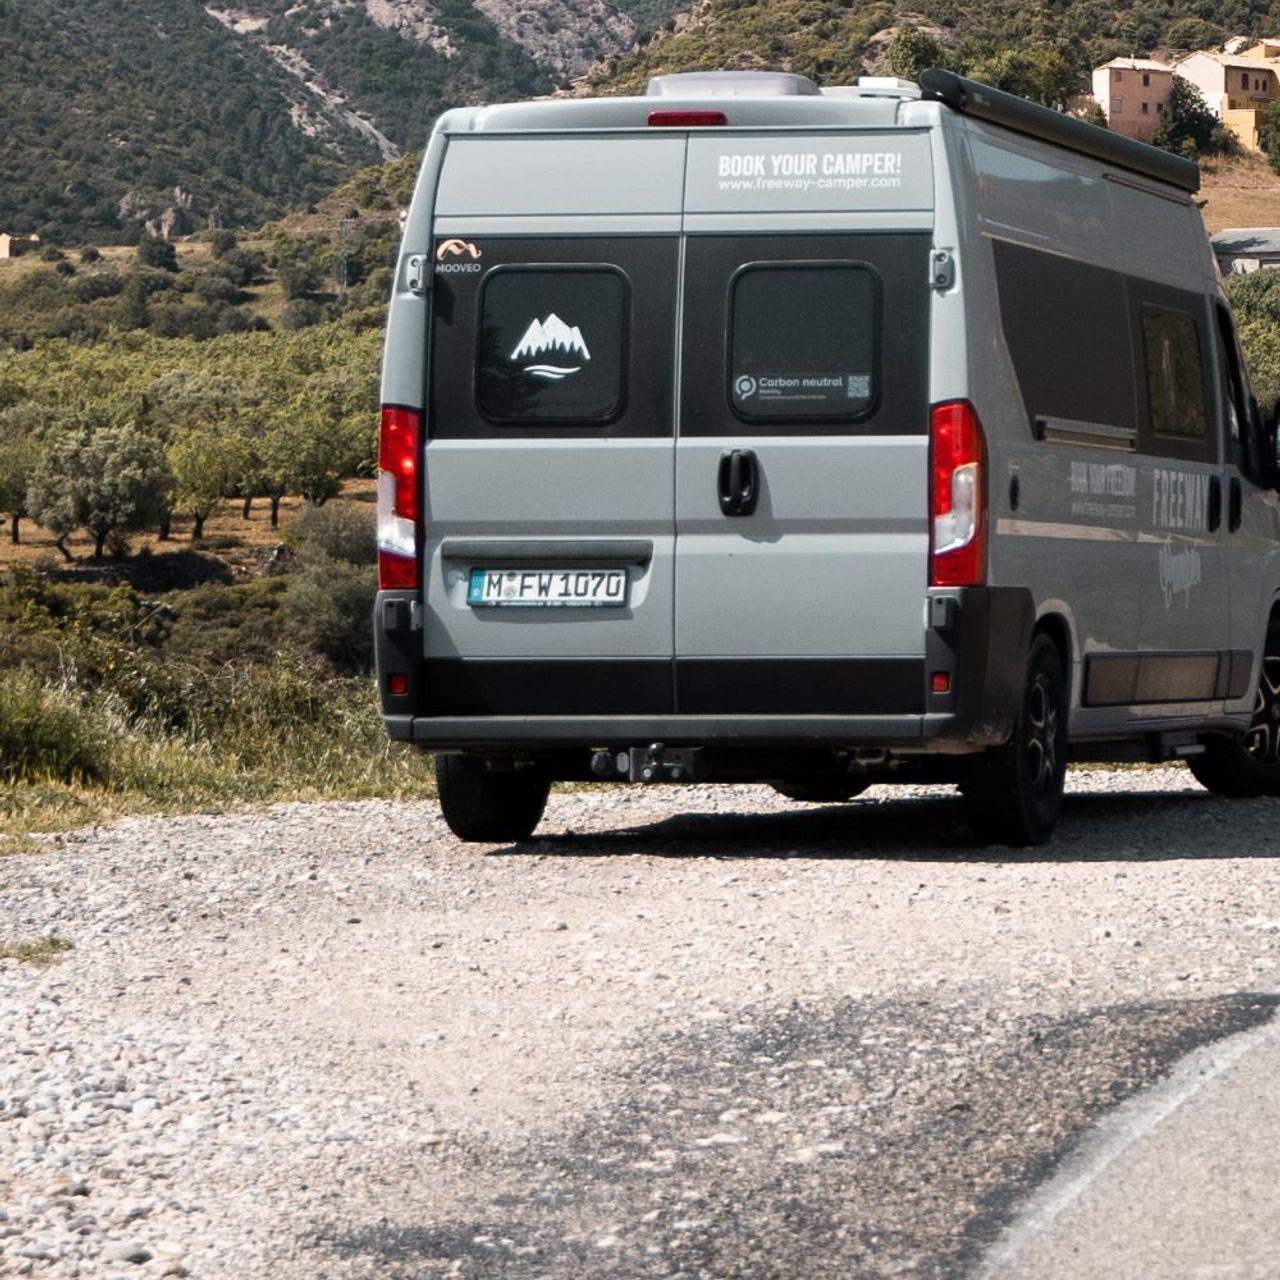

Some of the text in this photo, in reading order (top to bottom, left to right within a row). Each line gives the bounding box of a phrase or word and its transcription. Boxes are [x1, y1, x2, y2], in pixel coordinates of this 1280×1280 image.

[718, 152, 902, 177] BOOK YOUR CAMPER!
[718, 176, 901, 191] www.freeway-camper.com
[435, 263, 482, 274] MOOVEO
[759, 376, 843, 387] Carbon neutral
[1152, 468, 1210, 529] FREEWAY
[486, 573, 503, 598] M
[557, 572, 622, 598] 1070
